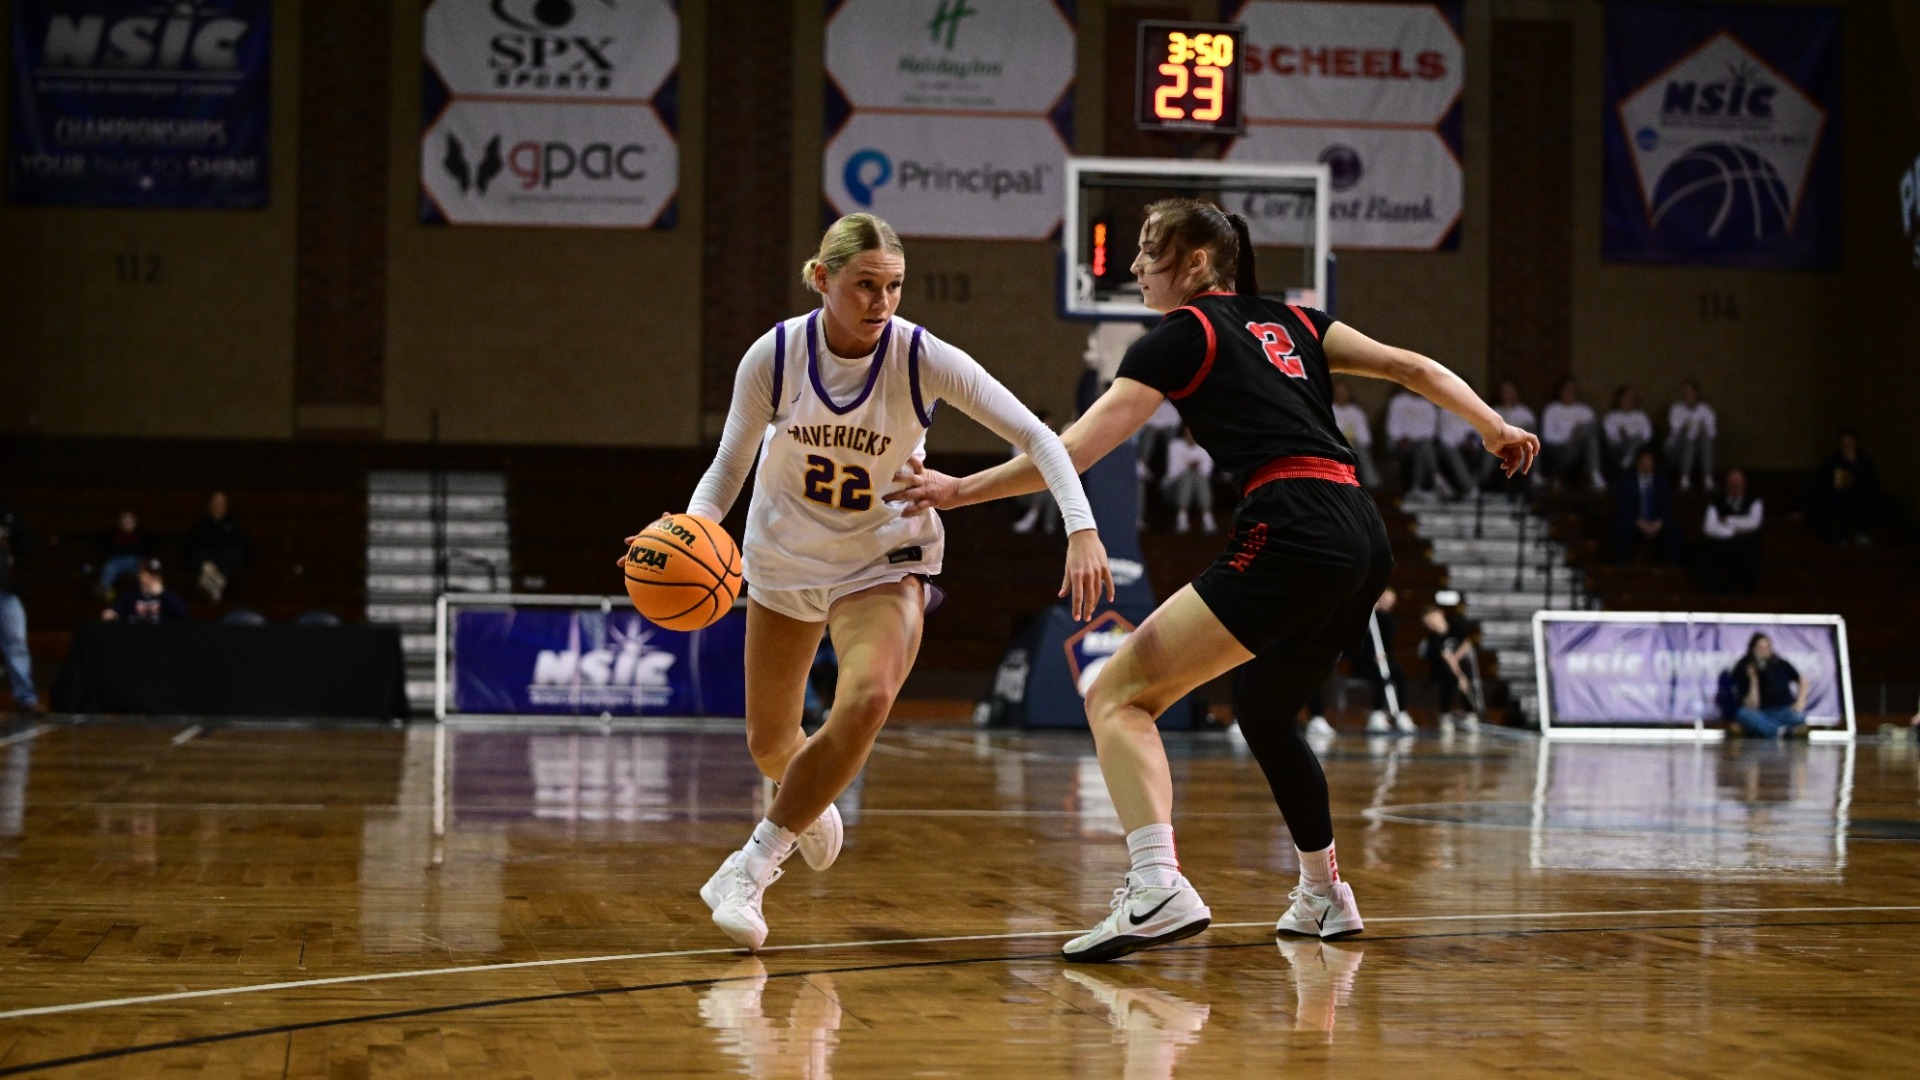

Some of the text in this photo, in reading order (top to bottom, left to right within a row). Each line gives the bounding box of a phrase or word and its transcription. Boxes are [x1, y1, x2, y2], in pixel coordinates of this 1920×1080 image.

[42, 4, 249, 70] NSIC
[488, 35, 615, 71] SPX
[1167, 31, 1235, 67] 3:50
[1243, 45, 1447, 80] SCHEELS
[496, 74, 611, 89] SPORTS
[1154, 63, 1225, 121] 23
[1662, 77, 1776, 118] NSIC
[54, 117, 228, 149] CHAMPIONSHIPS
[22, 152, 86, 178] YOUR
[188, 155, 258, 179] SHINE
[508, 141, 646, 189] gpac
[900, 161, 1044, 199] Principal
[1245, 320, 1308, 381] 2
[787, 424, 891, 456] MAVERICKS
[804, 453, 873, 512] 22
